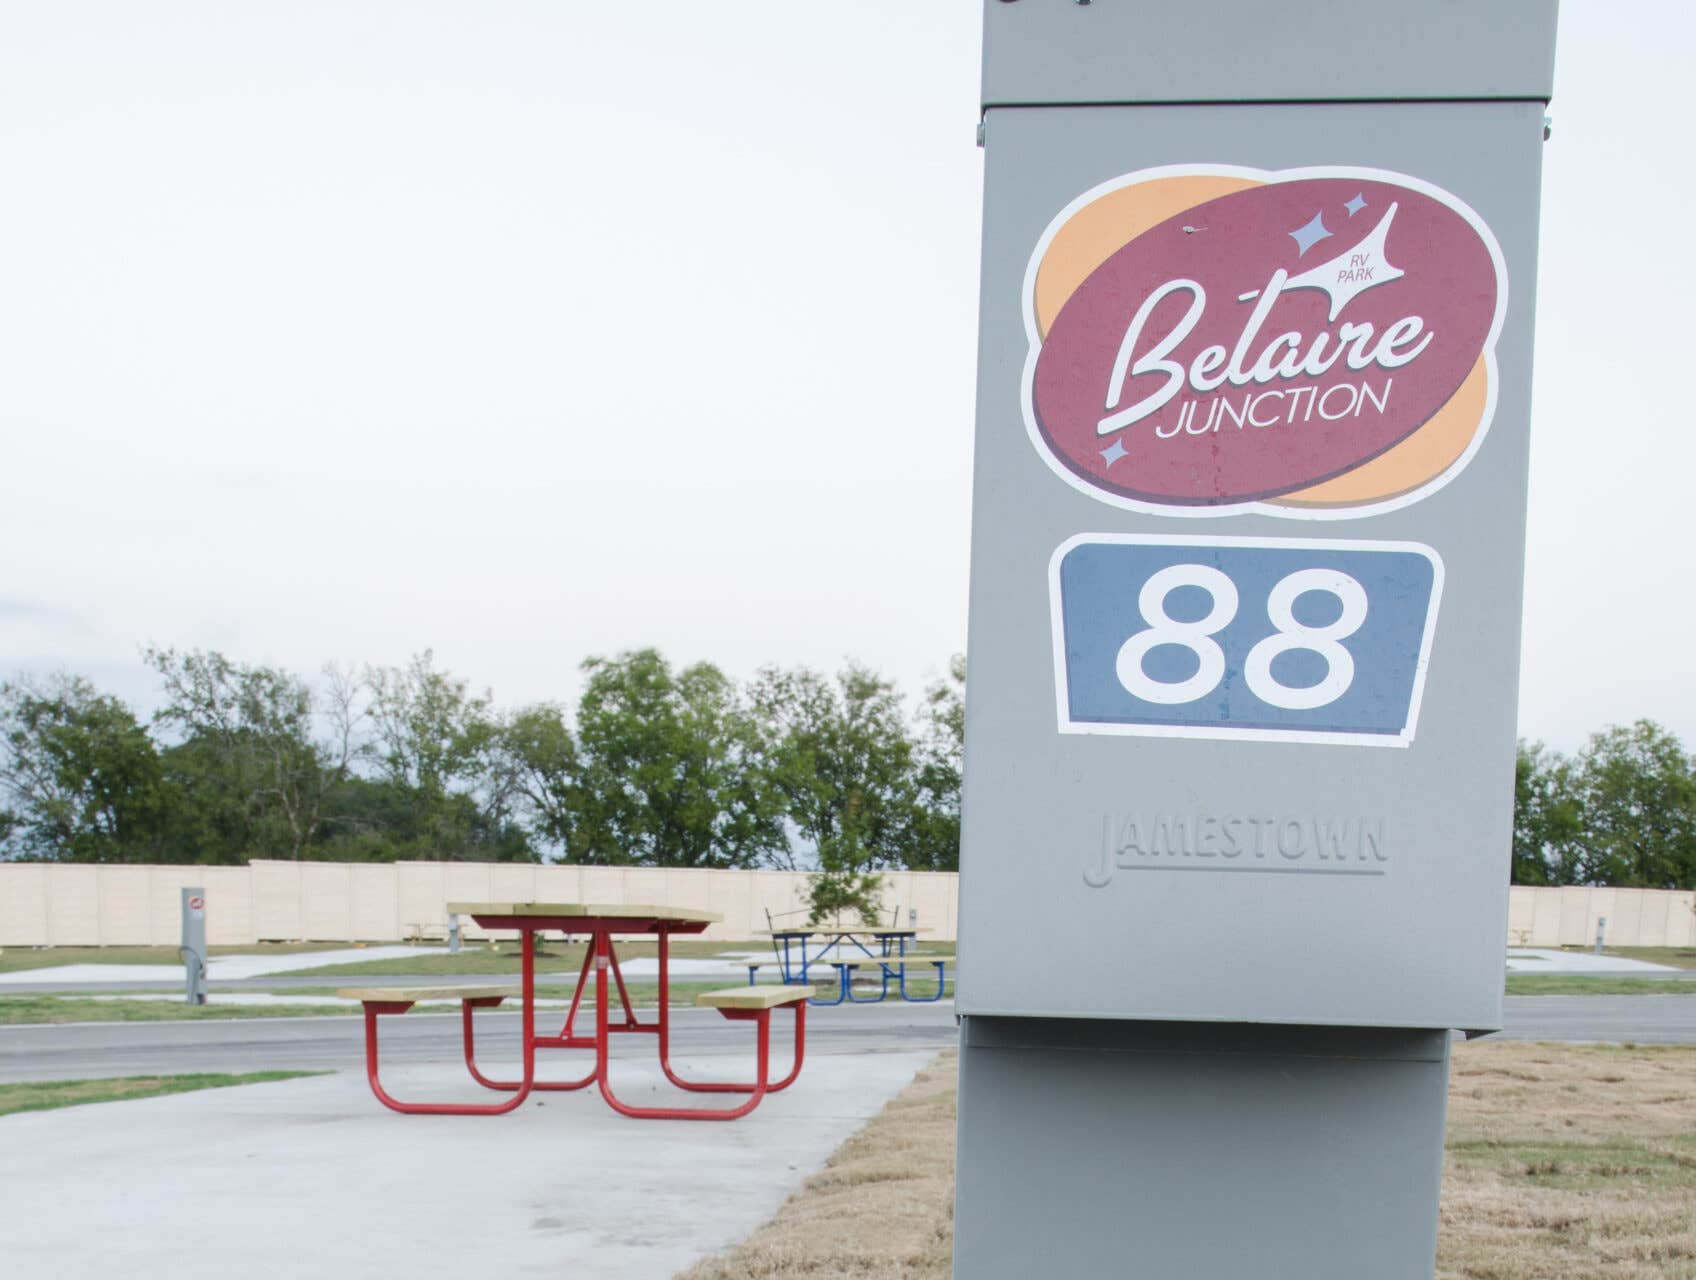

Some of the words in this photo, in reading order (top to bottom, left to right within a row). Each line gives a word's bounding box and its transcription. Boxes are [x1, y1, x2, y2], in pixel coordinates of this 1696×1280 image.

[1337, 267, 1375, 283] PARK
[1350, 254, 1370, 267] RV
[1155, 378, 1393, 440] JUNCTION
[1116, 563, 1369, 710] 88
[1083, 811, 1388, 888] JAMESTOWN
